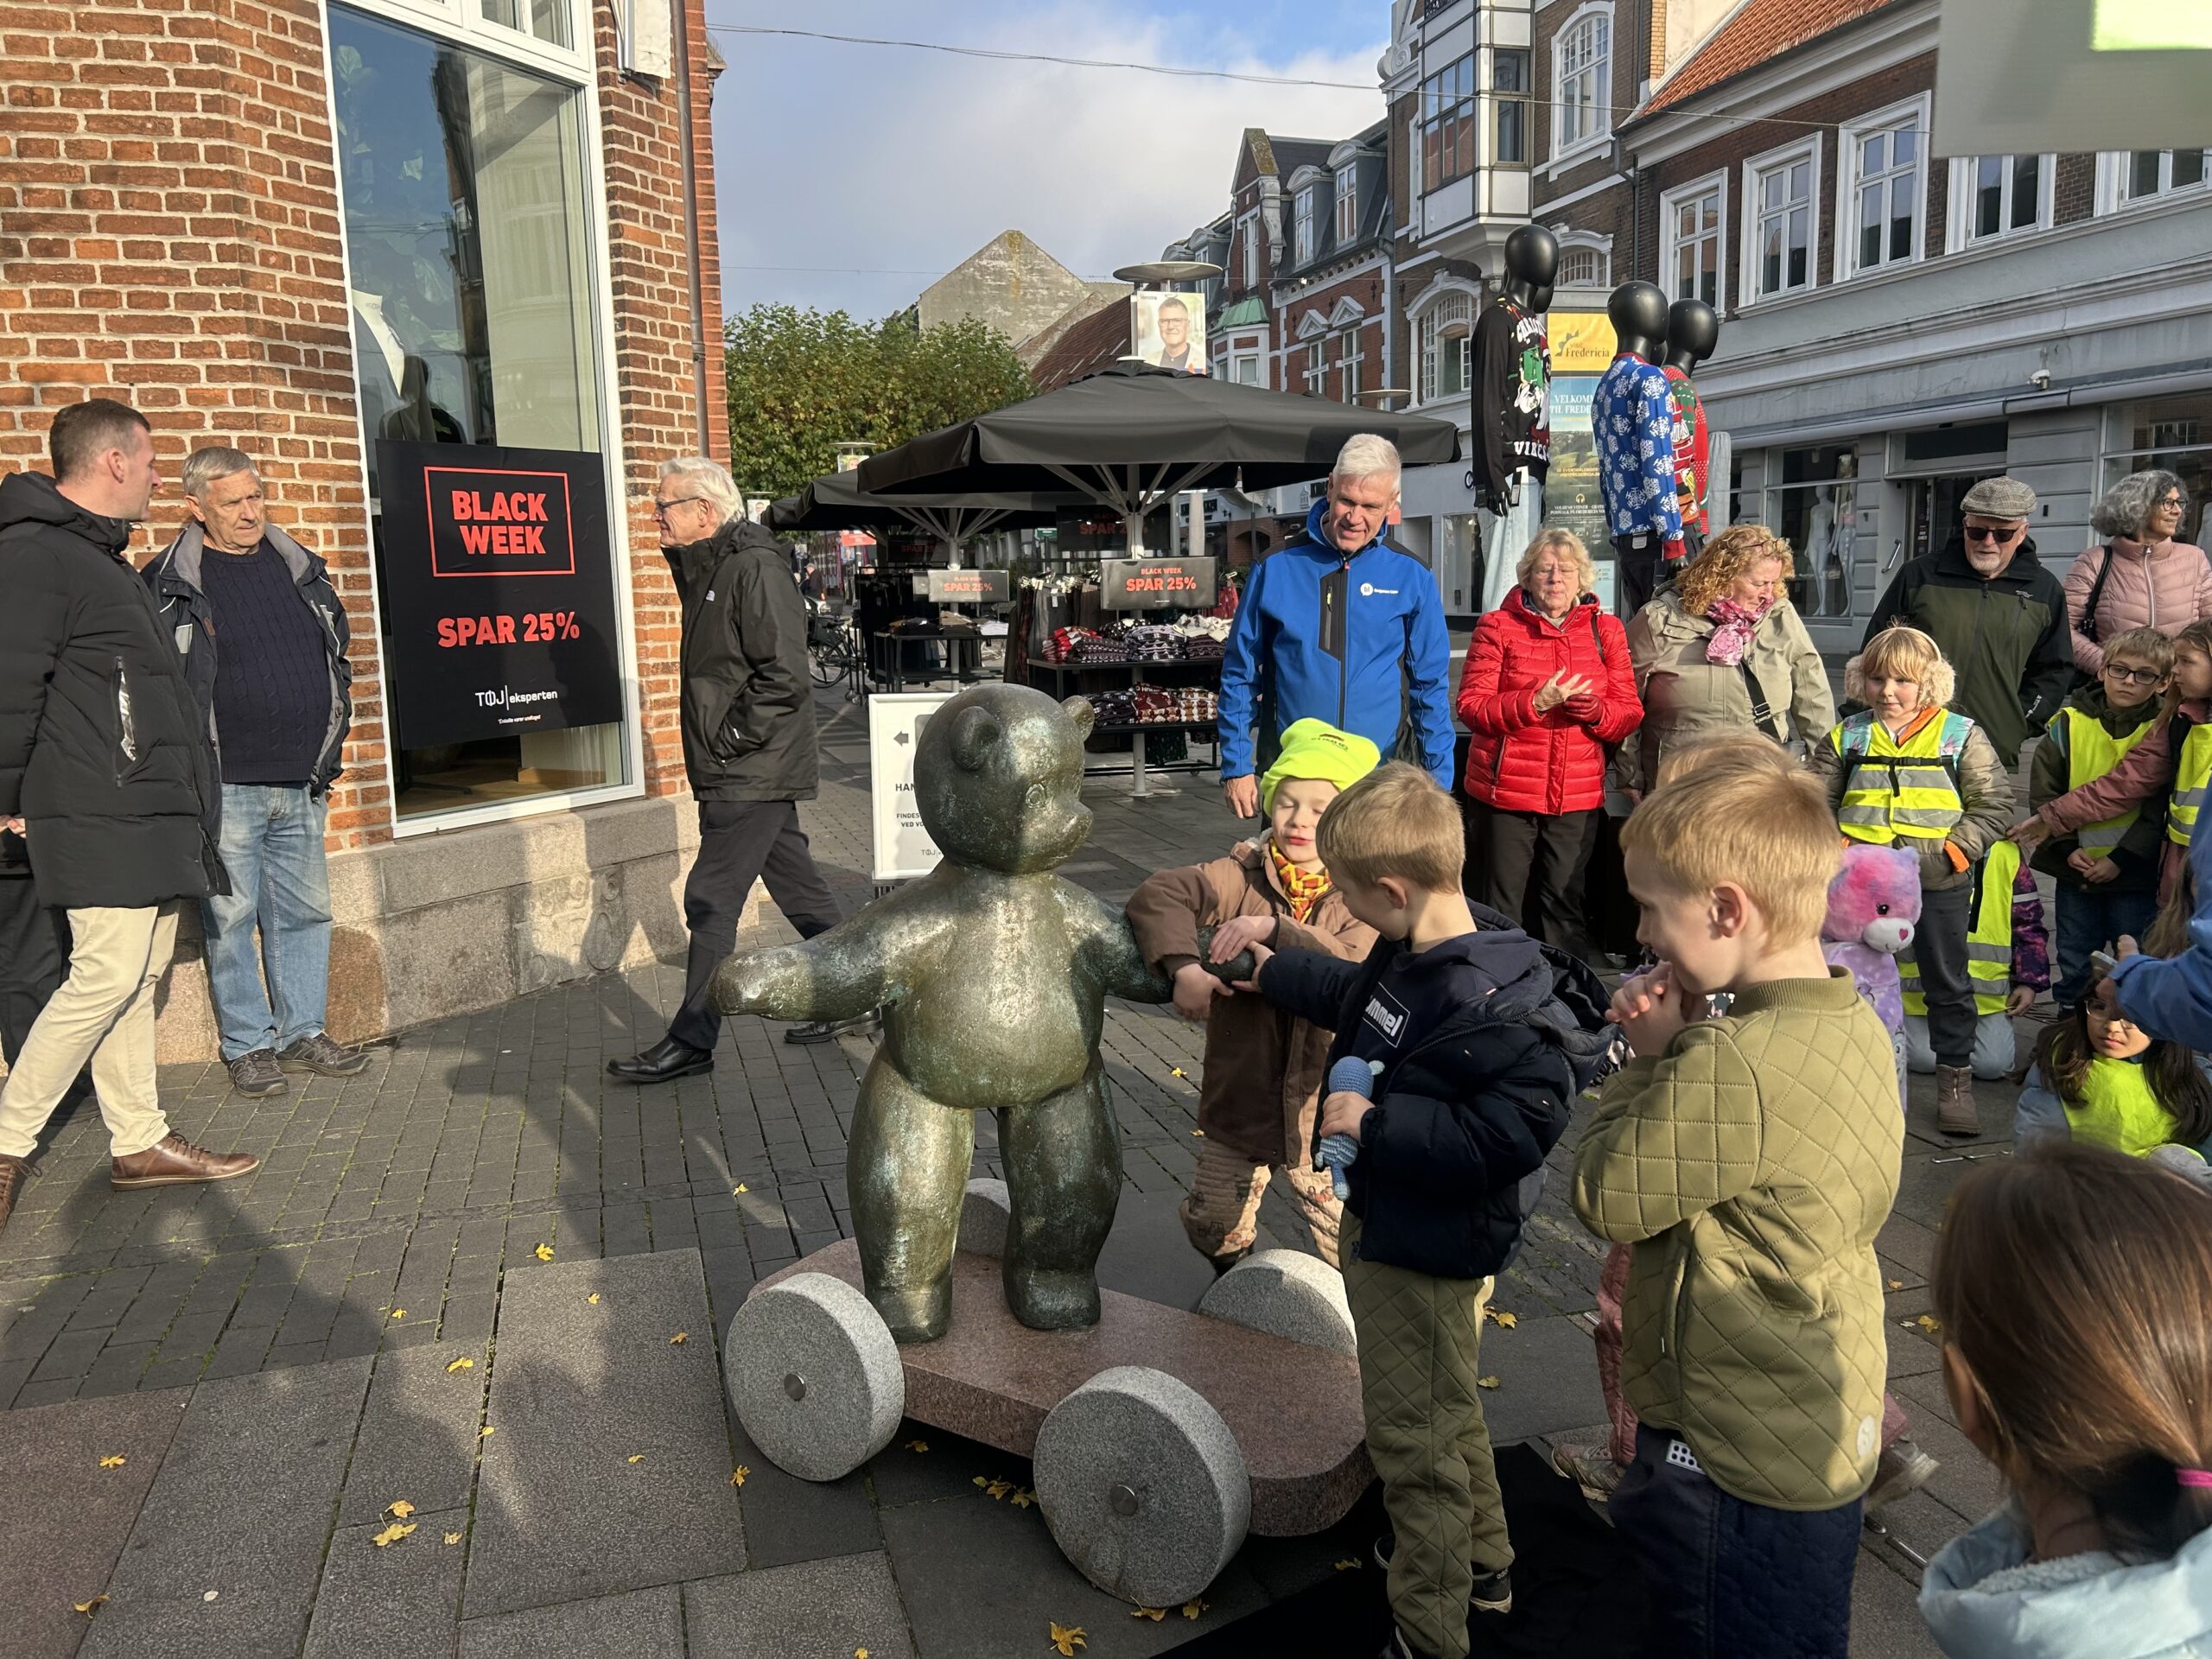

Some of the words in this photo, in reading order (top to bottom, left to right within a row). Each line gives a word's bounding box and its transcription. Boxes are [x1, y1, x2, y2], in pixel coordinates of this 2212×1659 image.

[1566, 347, 1610, 357] Fredericia
[452, 490, 549, 522] BLACK
[459, 524, 546, 554] WEEK
[944, 582, 970, 592] SPAR
[971, 582, 993, 592] 25%
[1126, 577, 1164, 592] SPAR
[1166, 576, 1197, 590] 25%
[437, 615, 517, 648] SPAR
[522, 611, 580, 642] 25%
[509, 690, 557, 704] eksperten
[1365, 997, 1403, 1037] mmel
